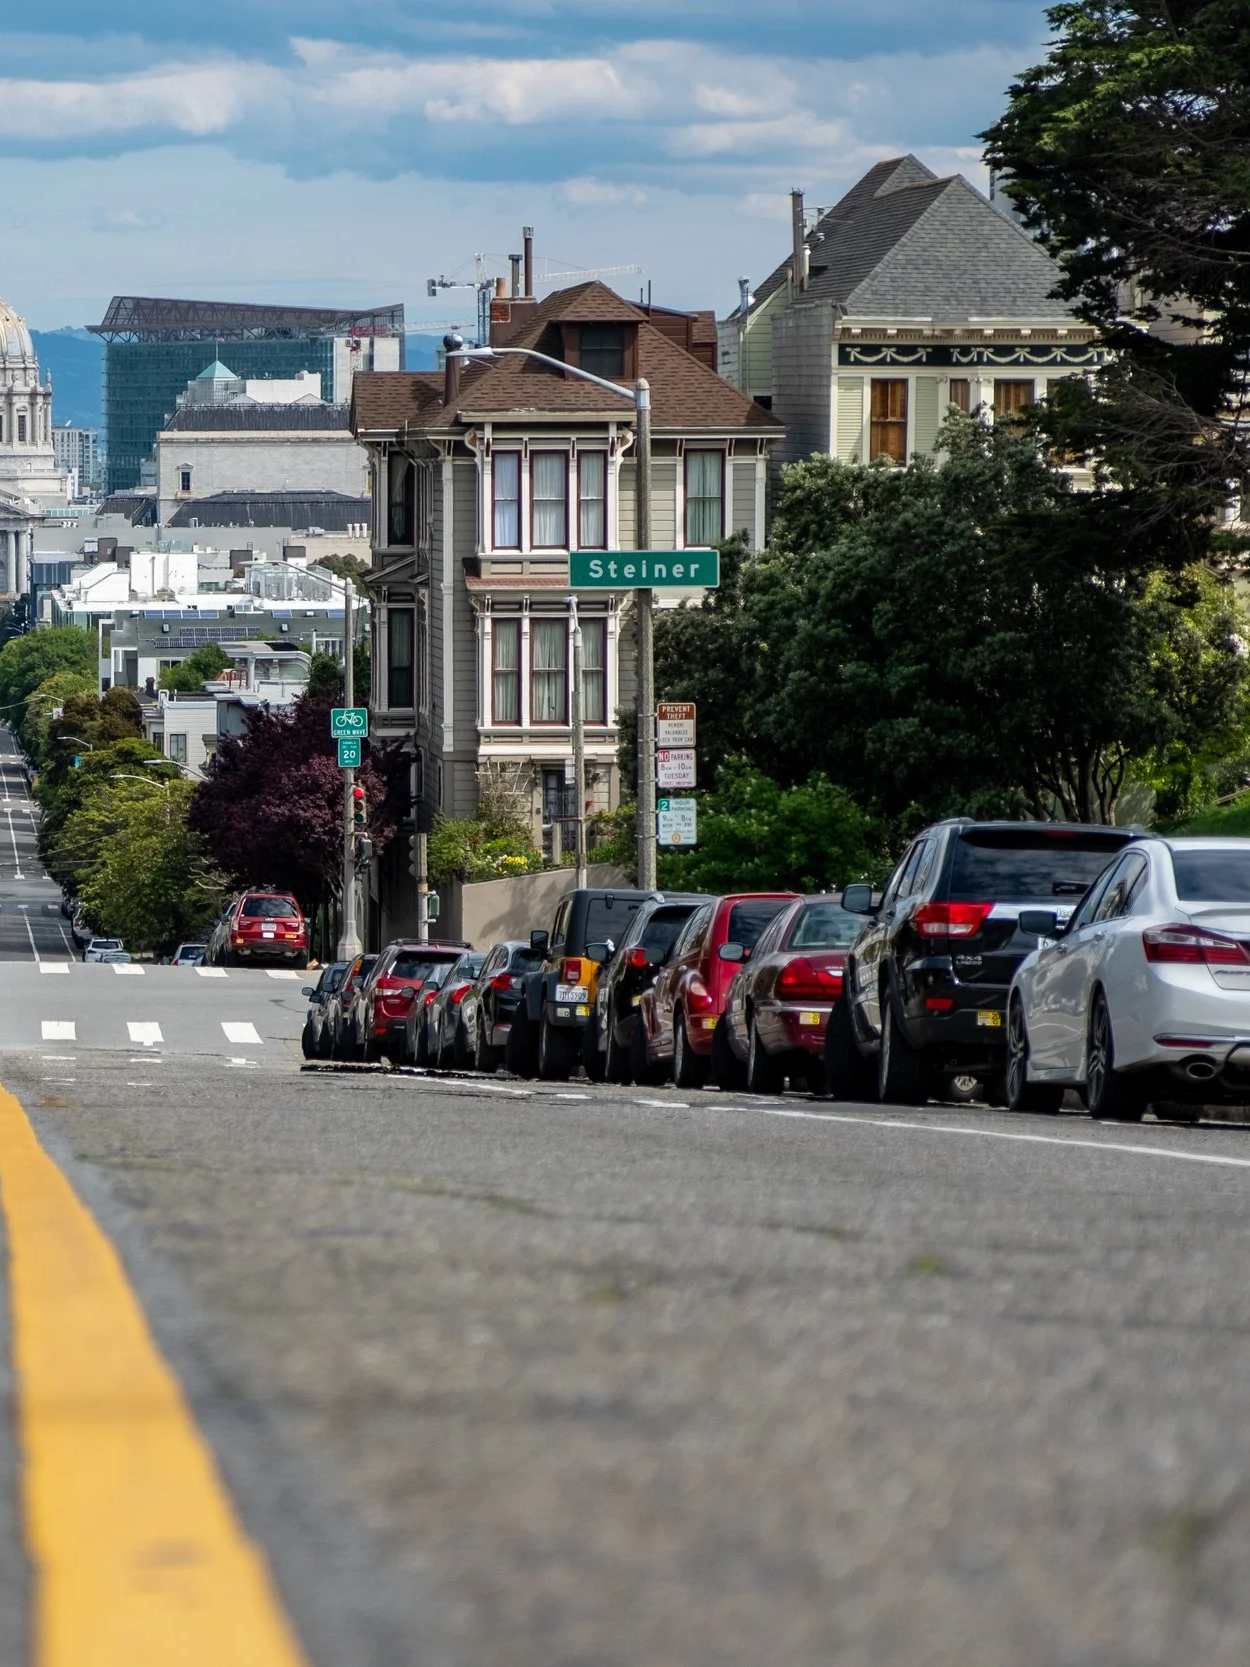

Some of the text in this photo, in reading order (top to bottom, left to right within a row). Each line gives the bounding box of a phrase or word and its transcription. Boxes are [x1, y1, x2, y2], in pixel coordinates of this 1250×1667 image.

[589, 559, 700, 578] Steiner
[344, 750, 356, 758] 20
[659, 752, 669, 761] NO
[661, 801, 668, 810] 2
